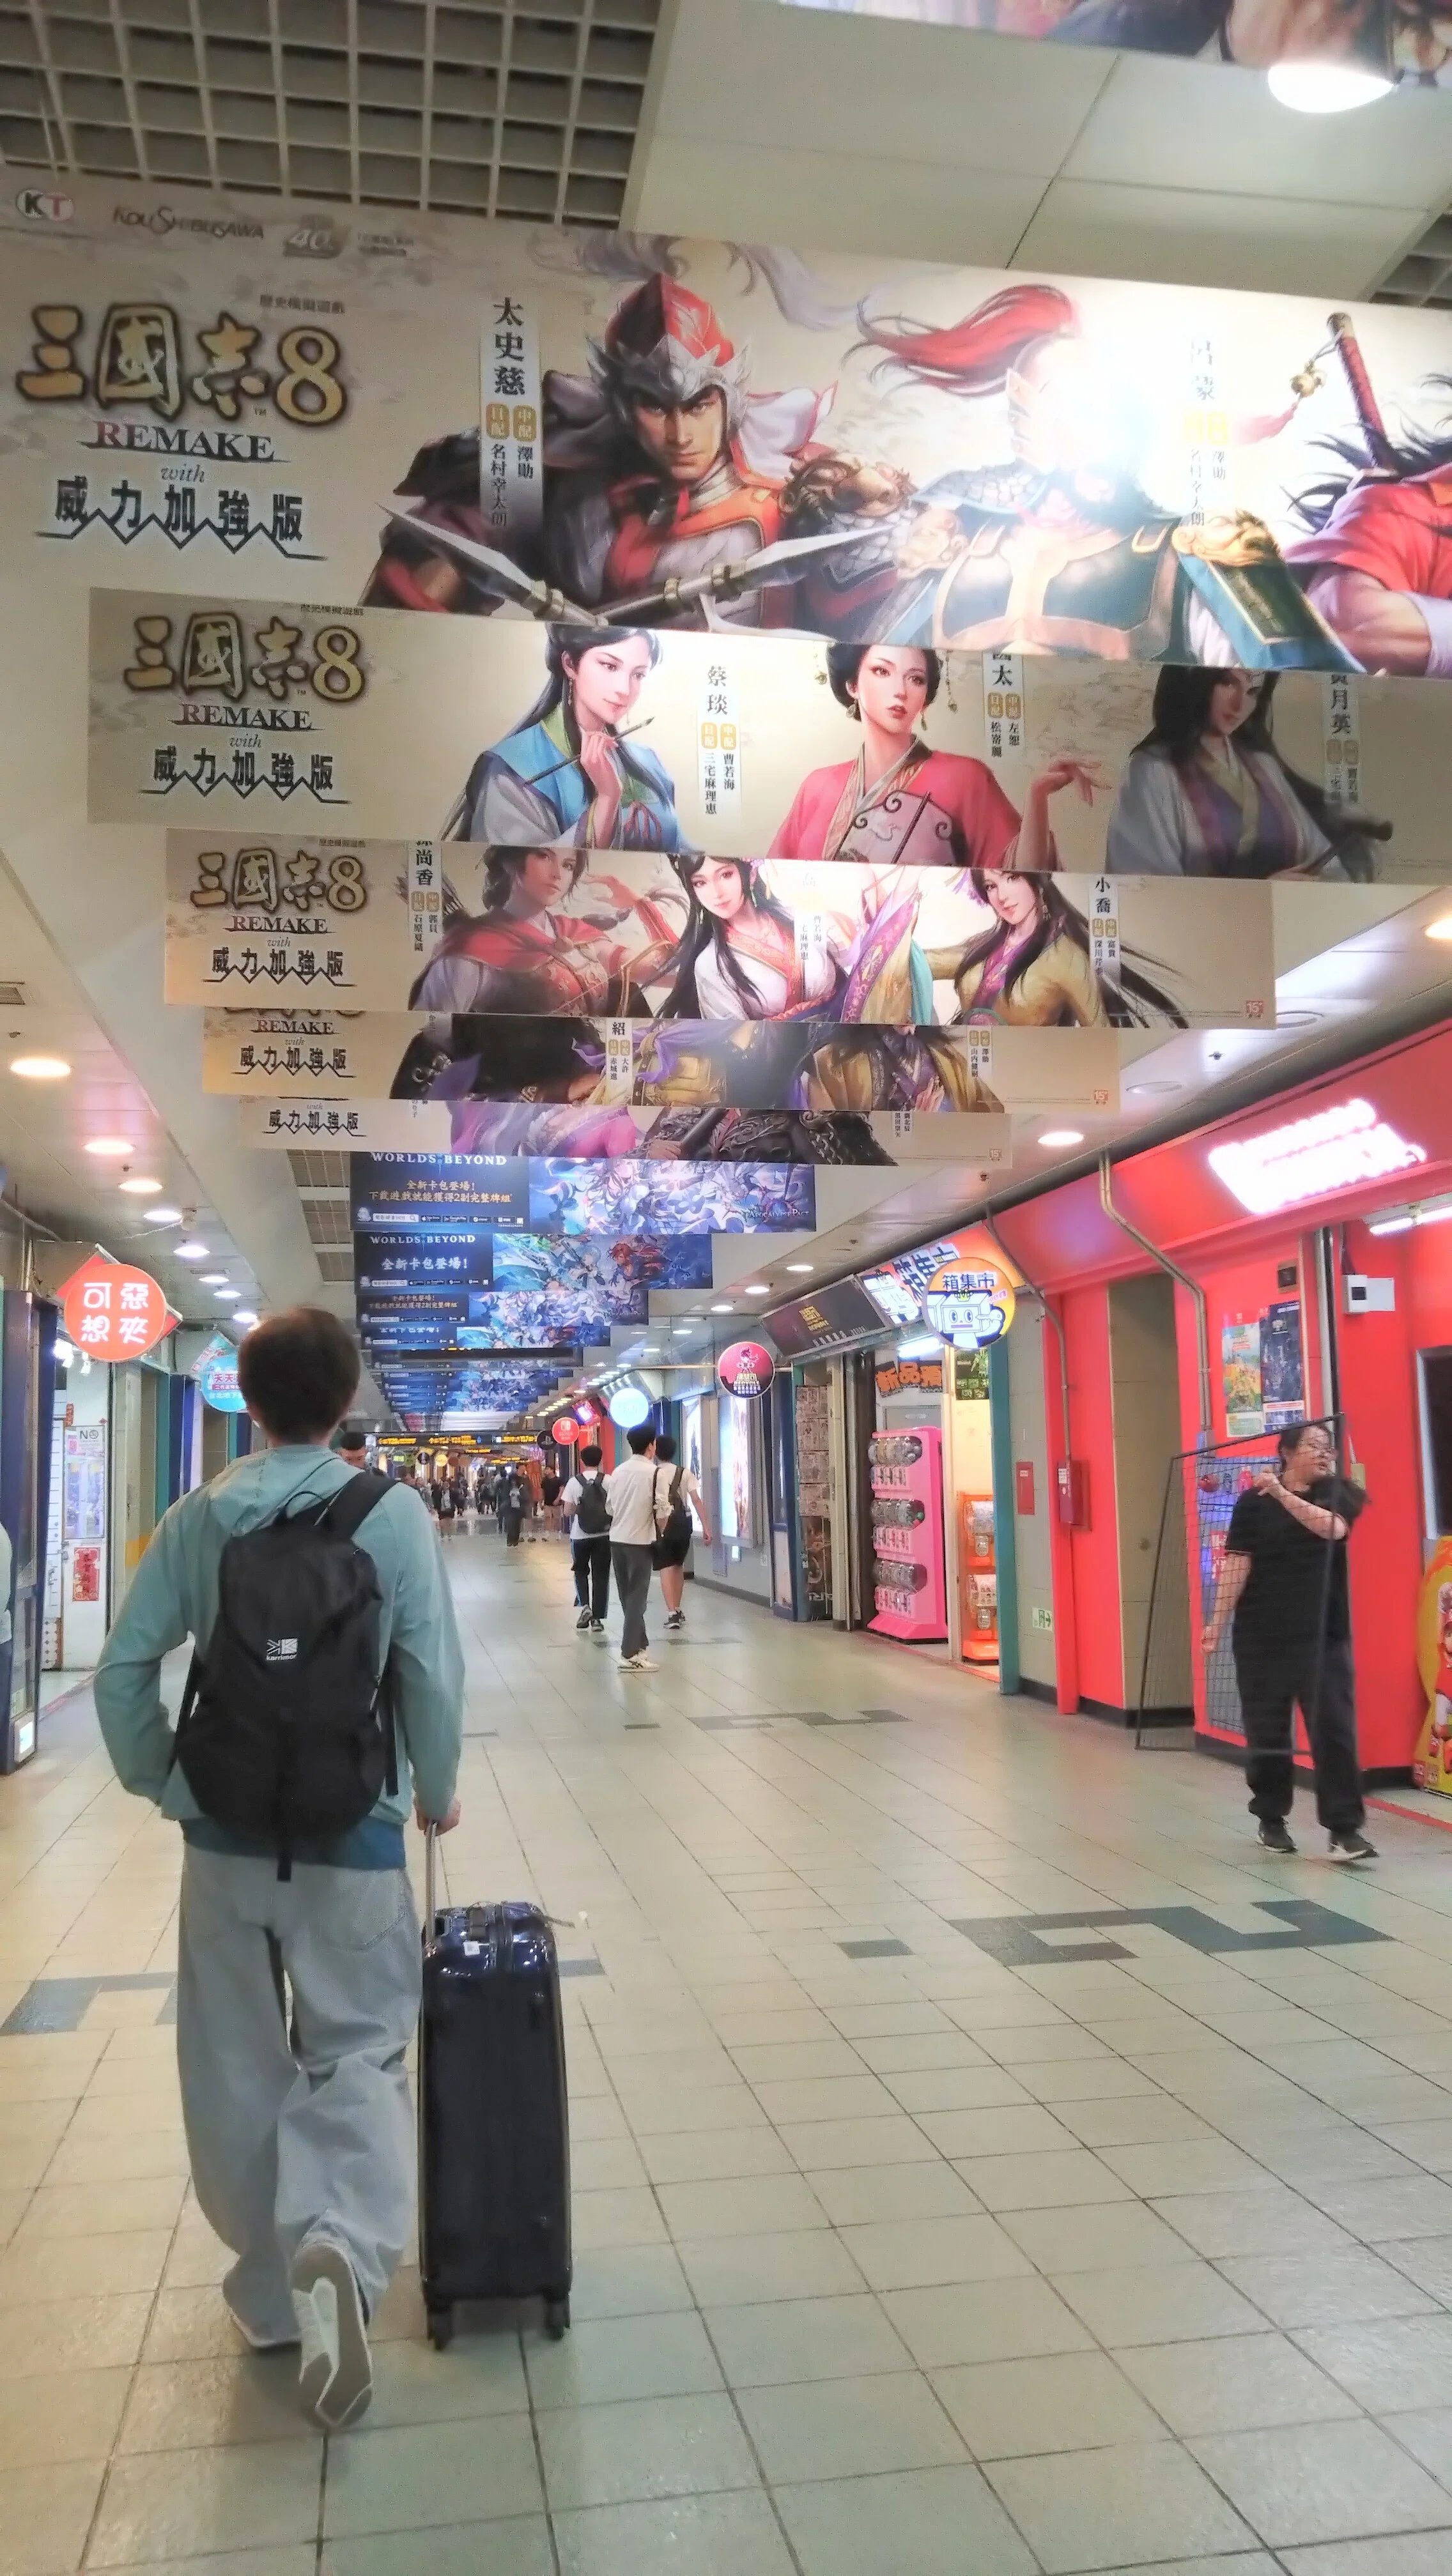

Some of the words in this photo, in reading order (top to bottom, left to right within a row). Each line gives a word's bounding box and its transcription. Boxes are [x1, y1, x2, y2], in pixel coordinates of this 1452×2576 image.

[24, 191, 72, 220] KT
[493, 296, 525, 395] 太史慈
[15, 302, 348, 426] 三國志8
[95, 420, 277, 462] REMAKE
[160, 464, 206, 483] with
[56, 475, 303, 544] 威力加強版
[123, 611, 366, 703] 三國志8
[706, 665, 729, 716] 蔡琰
[181, 703, 313, 730] REMAKE
[229, 735, 262, 749] with
[153, 745, 334, 791] 威力加強版
[723, 753, 735, 790] 曹若海
[190, 847, 366, 913] 三國志8
[1095, 877, 1111, 914] 小喬
[231, 916, 328, 933] REMAKE
[267, 937, 291, 948] with
[212, 946, 343, 977] 威力加強版
[254, 1019, 335, 1034] REMAKE
[612, 1022, 626, 1036] 紹
[284, 1037, 305, 1046] with
[240, 1045, 346, 1070] 威力加強版
[268, 1109, 359, 1130] 威力加強版
[371, 1152, 436, 1163] WORLDS
[444, 1154, 507, 1166] BEYOND
[406, 1180, 475, 1191] 全新卡包登場!
[370, 1236, 421, 1245] WORLDS
[426, 1234, 476, 1243] BEYOND
[381, 1256, 468, 1271] 全新卡包登場!
[942, 1273, 996, 1290] 箱集市
[83, 1282, 149, 1310] 可惡
